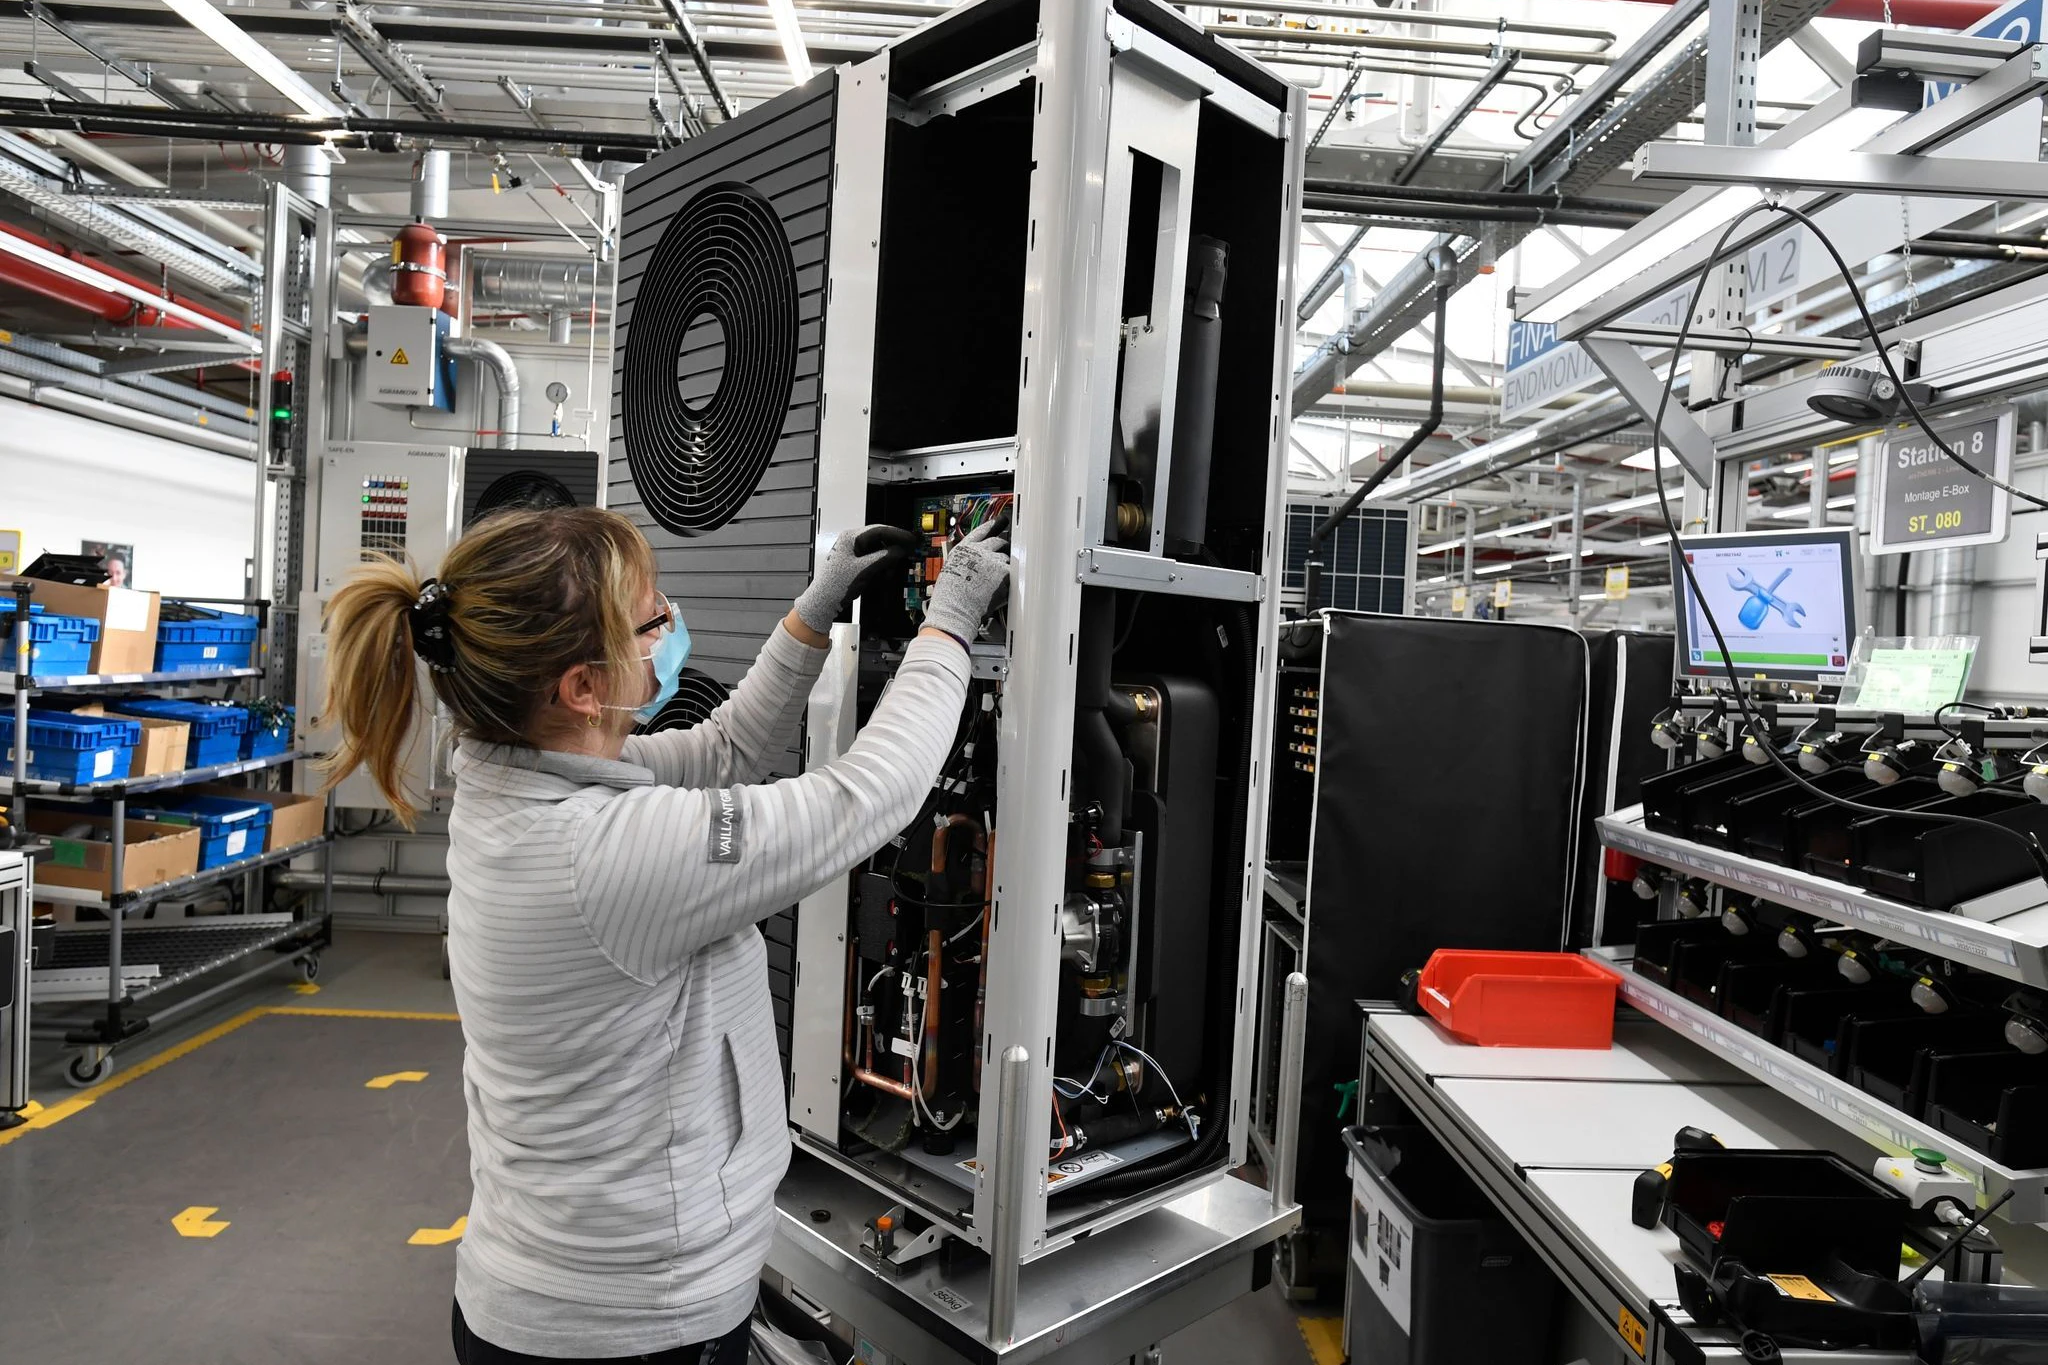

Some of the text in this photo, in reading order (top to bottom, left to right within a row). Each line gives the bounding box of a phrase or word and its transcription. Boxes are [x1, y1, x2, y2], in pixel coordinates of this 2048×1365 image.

[1777, 238, 1797, 285] 2
[1897, 431, 1984, 469] Station 8
[1904, 489, 1940, 503] Montage
[1942, 484, 1970, 498] E-Box
[1908, 510, 1962, 535] ST_080
[933, 1290, 963, 1310] 350kg
